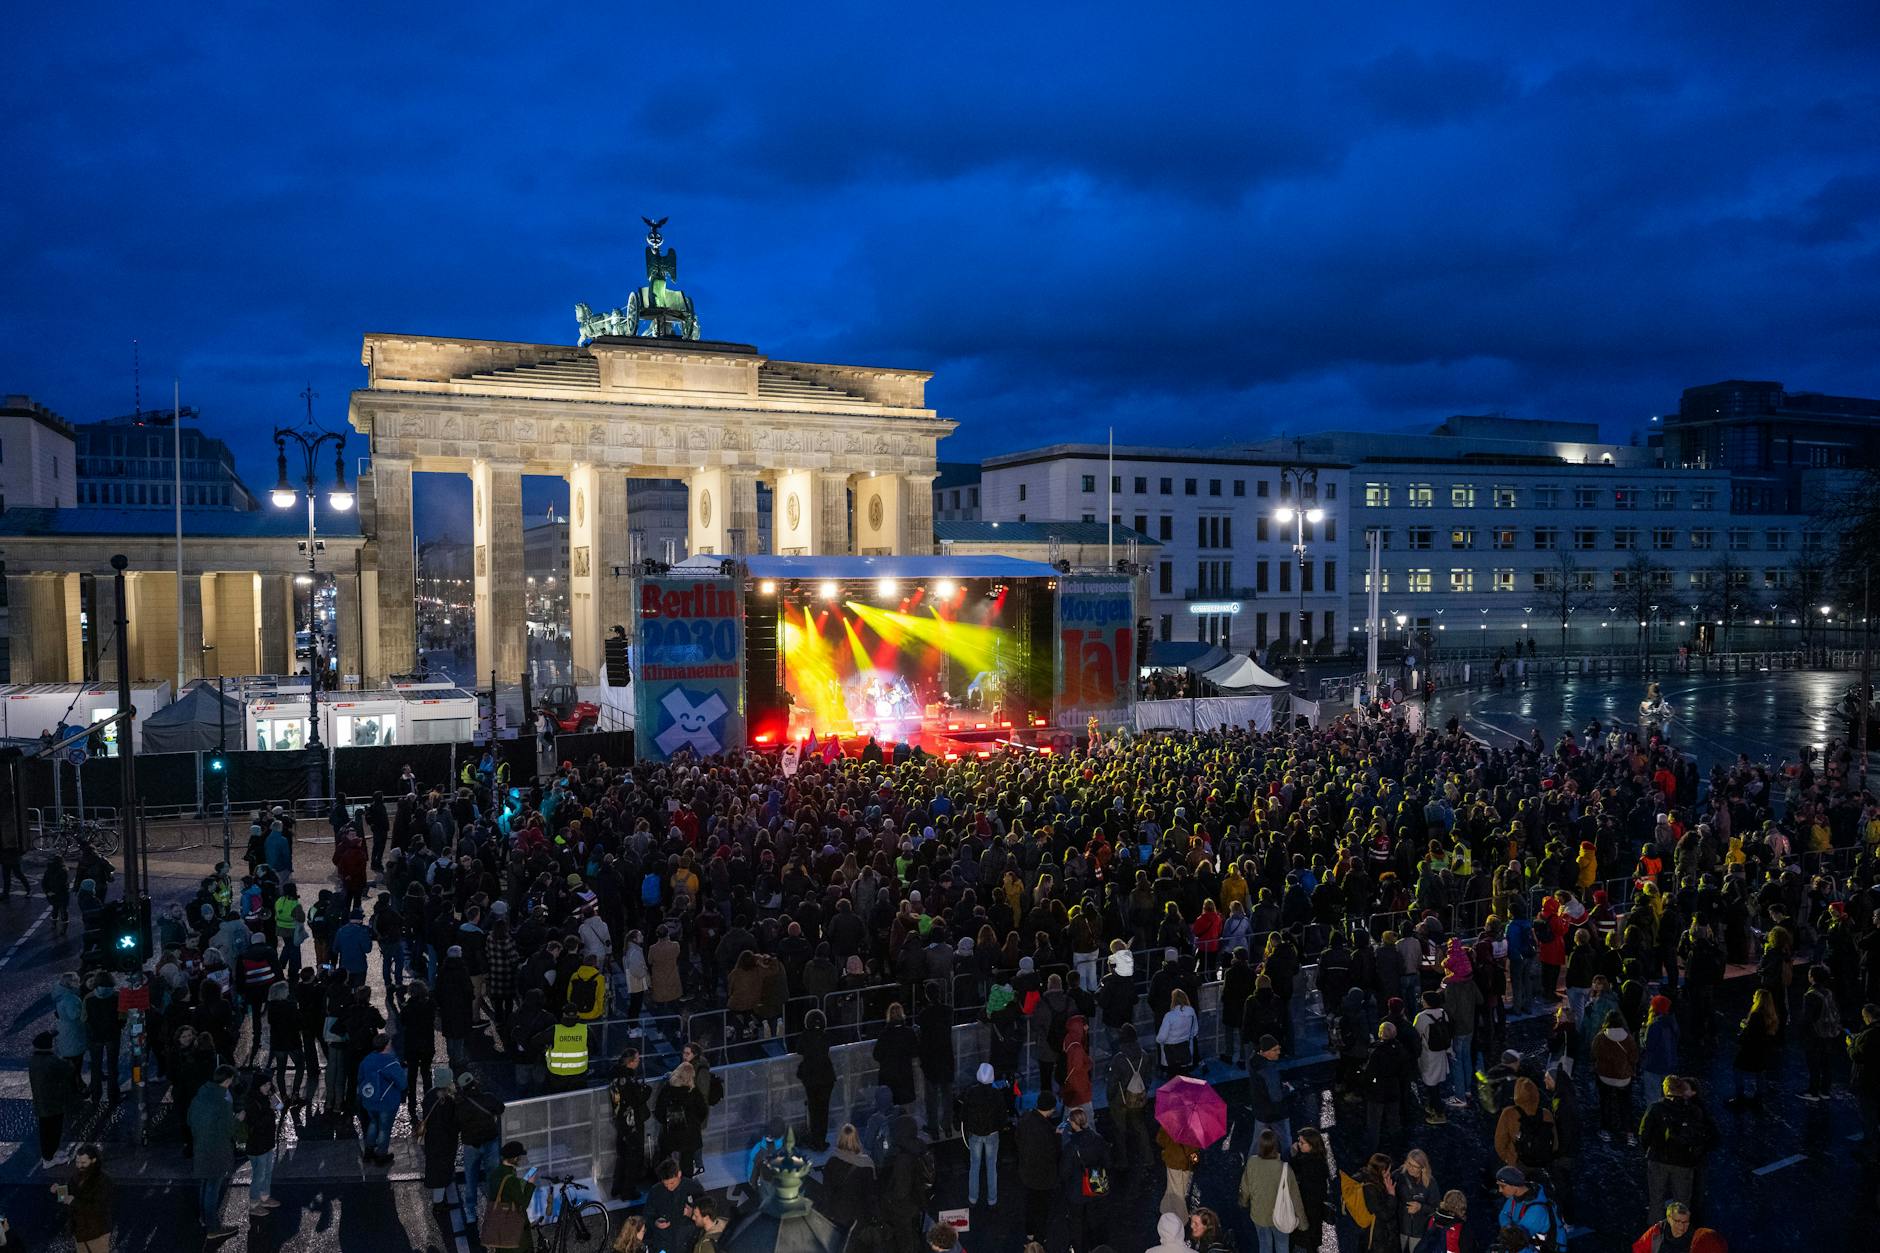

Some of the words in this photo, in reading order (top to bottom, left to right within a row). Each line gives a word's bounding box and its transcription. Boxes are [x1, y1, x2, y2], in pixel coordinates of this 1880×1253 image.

[640, 583, 736, 618] Berlin
[1060, 597, 1132, 626] Morgen
[641, 619, 736, 663] 2030
[641, 661, 740, 681] Klimaneutral
[1057, 628, 1133, 704] Ja!
